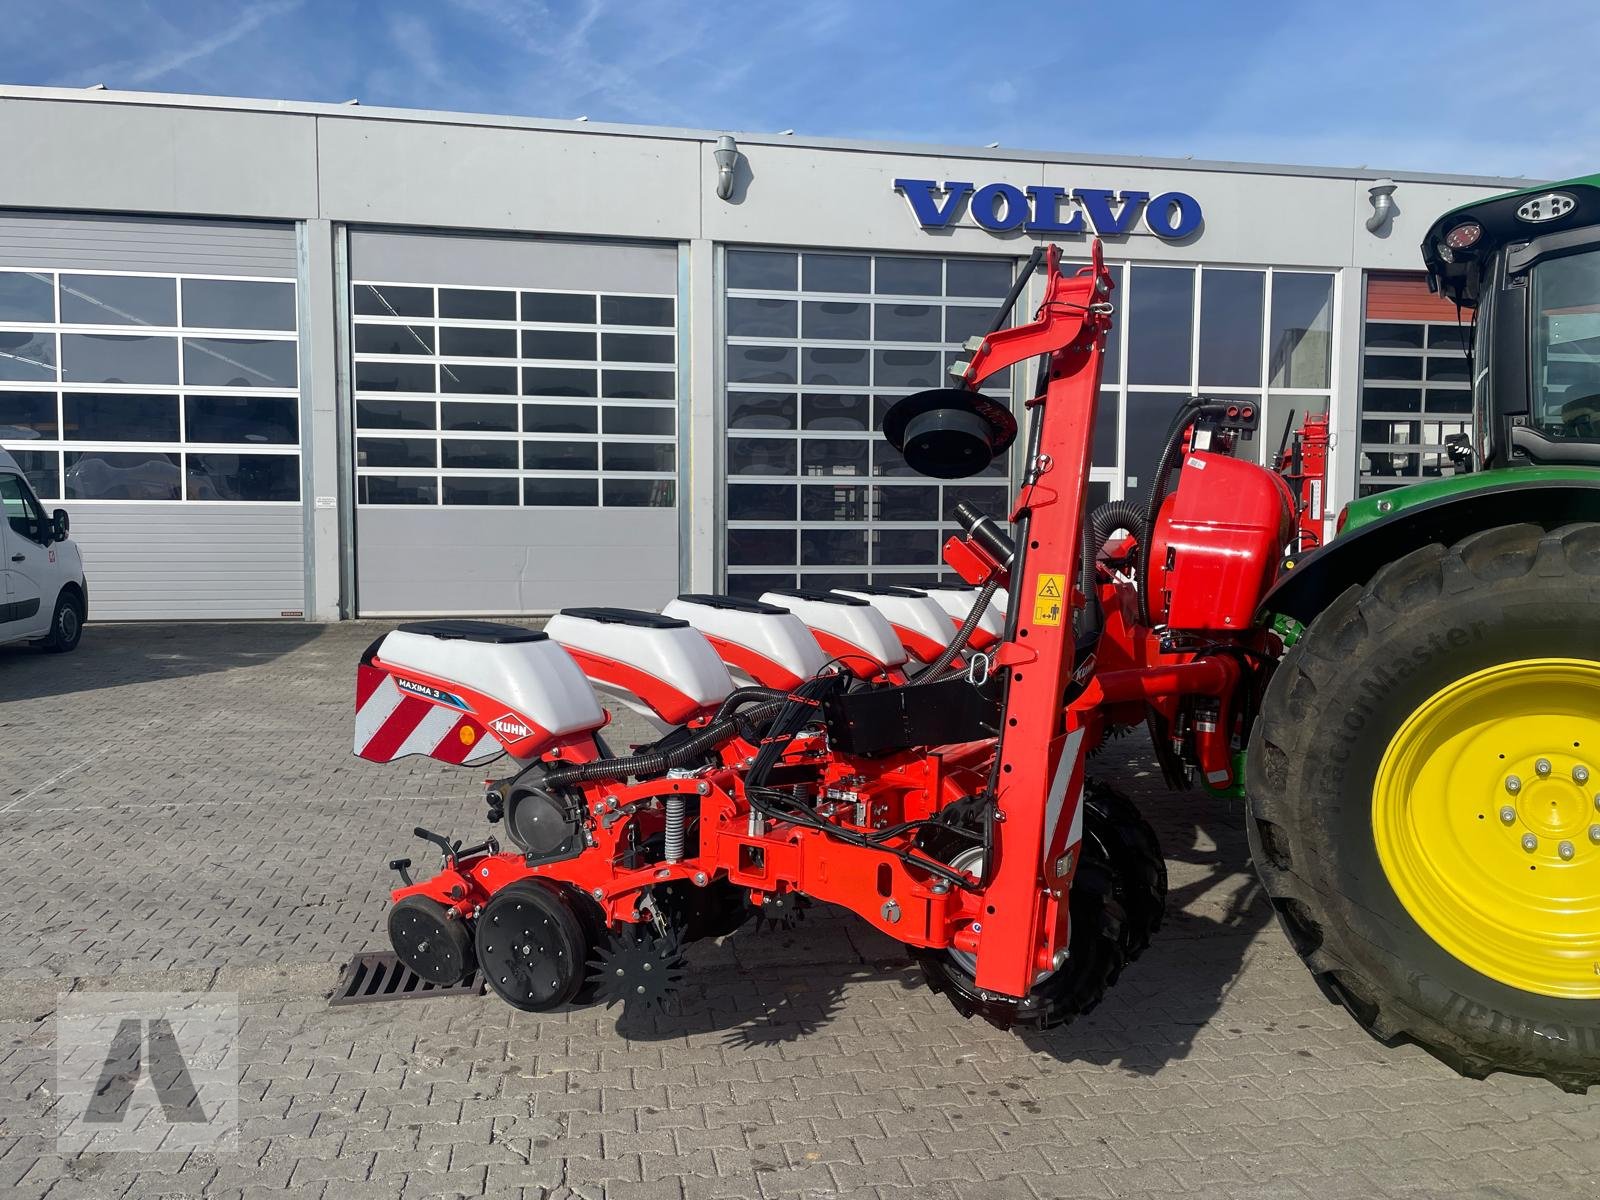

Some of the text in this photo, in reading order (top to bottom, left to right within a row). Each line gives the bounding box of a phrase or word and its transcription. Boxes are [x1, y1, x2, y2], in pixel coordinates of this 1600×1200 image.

[891, 179, 1204, 239] VOLVO
[399, 679, 431, 695] MAXIMA
[433, 690, 440, 698] 3
[495, 721, 527, 737] KUHN
